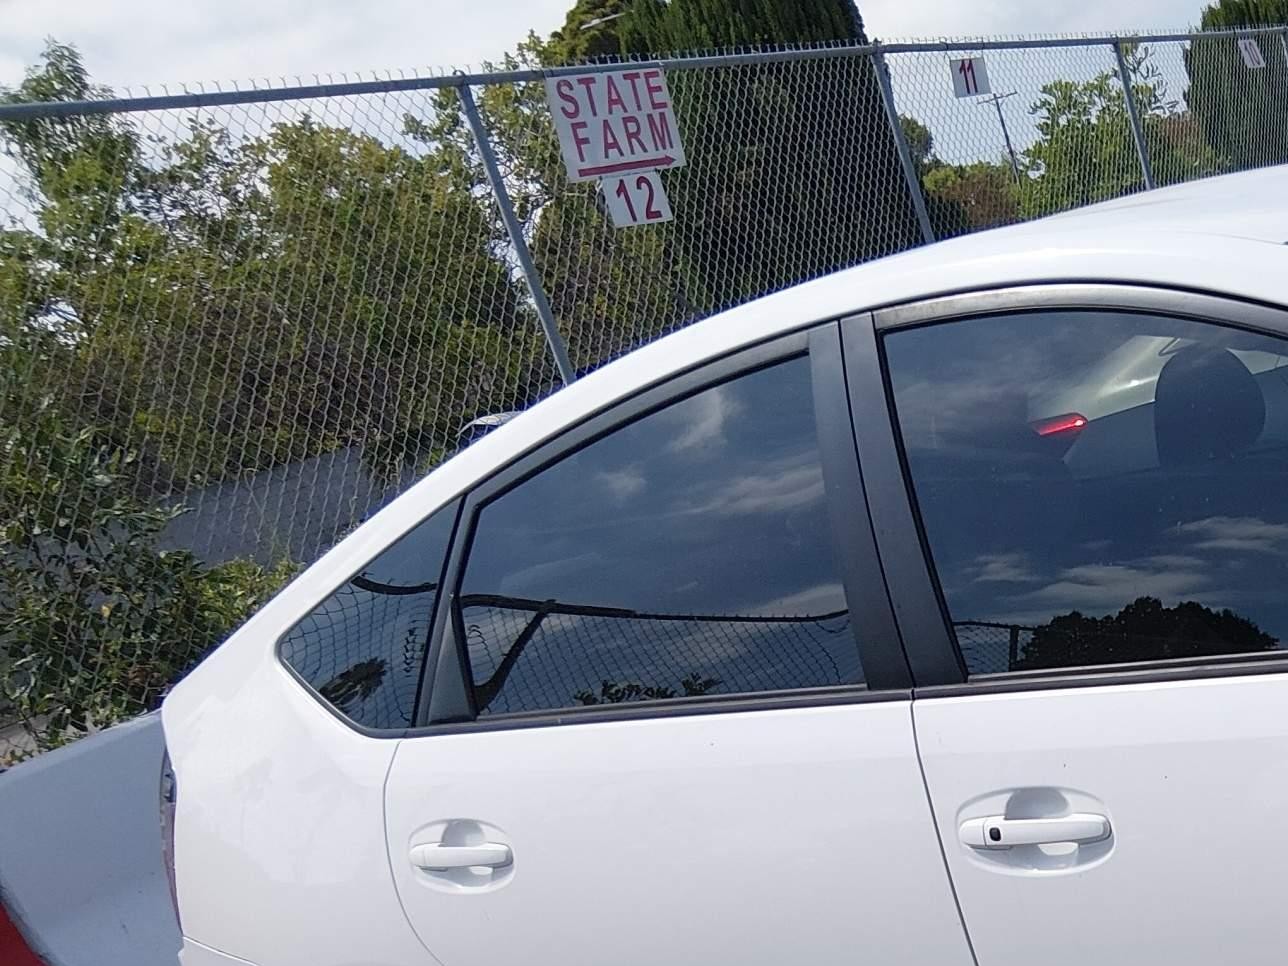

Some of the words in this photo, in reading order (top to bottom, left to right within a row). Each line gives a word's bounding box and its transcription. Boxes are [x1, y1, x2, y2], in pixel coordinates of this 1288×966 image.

[556, 71, 668, 119] STATE
[959, 59, 978, 94] 11
[570, 112, 674, 163] FARM
[616, 175, 663, 222] 12
